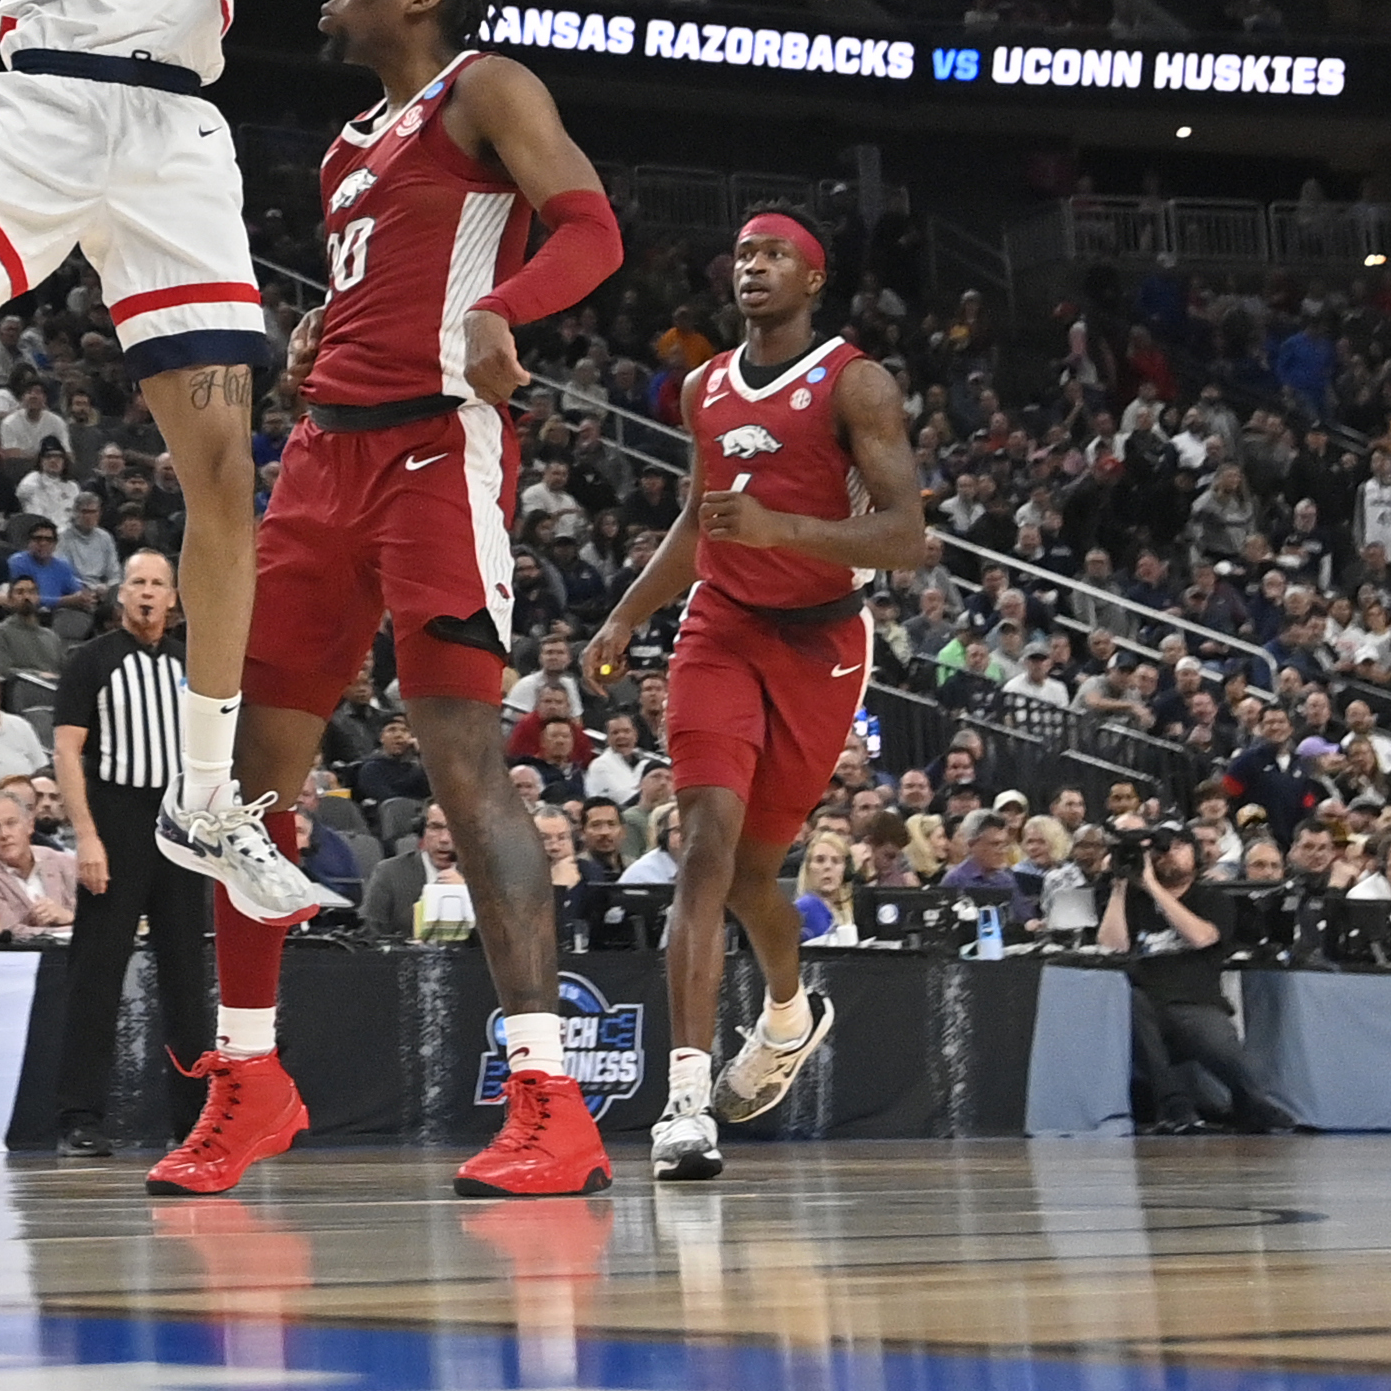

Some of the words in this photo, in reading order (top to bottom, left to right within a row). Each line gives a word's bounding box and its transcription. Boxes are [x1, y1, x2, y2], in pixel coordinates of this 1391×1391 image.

[645, 19, 915, 79] RAZORBACKS
[932, 48, 979, 81] VS
[991, 46, 1143, 88] UCONN
[1154, 52, 1346, 96] HUSKIES
[564, 1050, 638, 1083] DNESS
